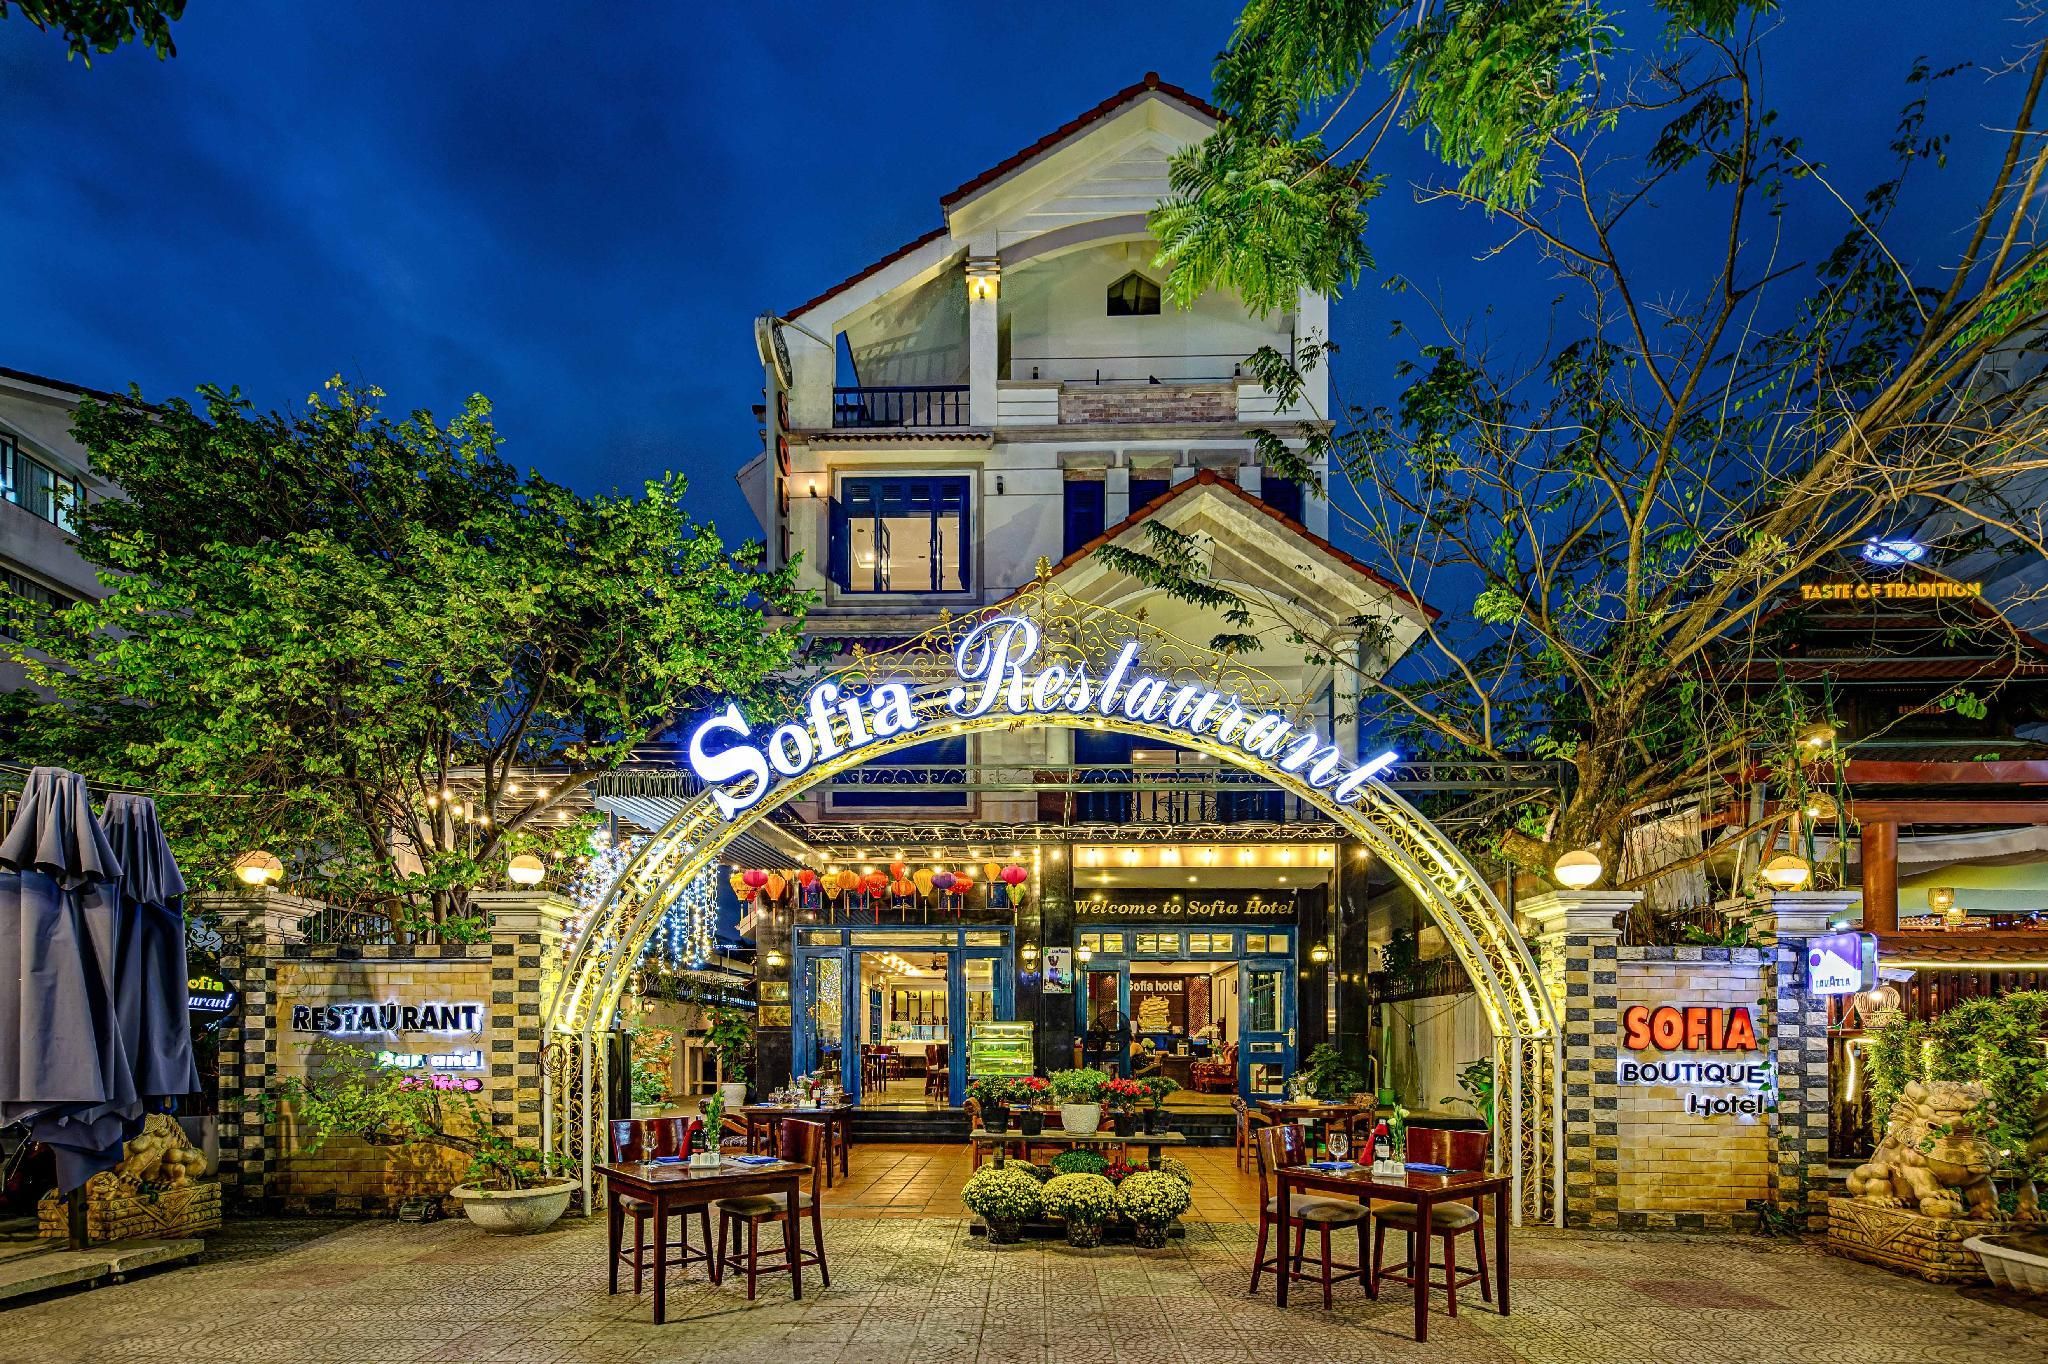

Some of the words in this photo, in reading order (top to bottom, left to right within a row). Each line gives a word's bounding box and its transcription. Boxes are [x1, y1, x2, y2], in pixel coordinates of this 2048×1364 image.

[1801, 584, 1852, 599] TASTE
[1884, 582, 1981, 598] TRADITION
[689, 681, 919, 822] Sofia
[949, 615, 1400, 804] Restaurant
[1074, 900, 1157, 915] Welcome
[1162, 901, 1181, 914] to
[1187, 900, 1239, 917] Sofia
[1243, 900, 1295, 915] Hotel
[188, 976, 224, 992] ofia
[1129, 980, 1154, 992] Sofia
[1155, 980, 1183, 992] hotel
[188, 993, 233, 1009] urant
[292, 1004, 479, 1032] RESTAURANT
[1622, 1005, 1758, 1051] SOFIA
[430, 1050, 482, 1069] and
[1622, 1062, 1766, 1085] BOUTIQUE
[1689, 1093, 1764, 1117] Hotel
